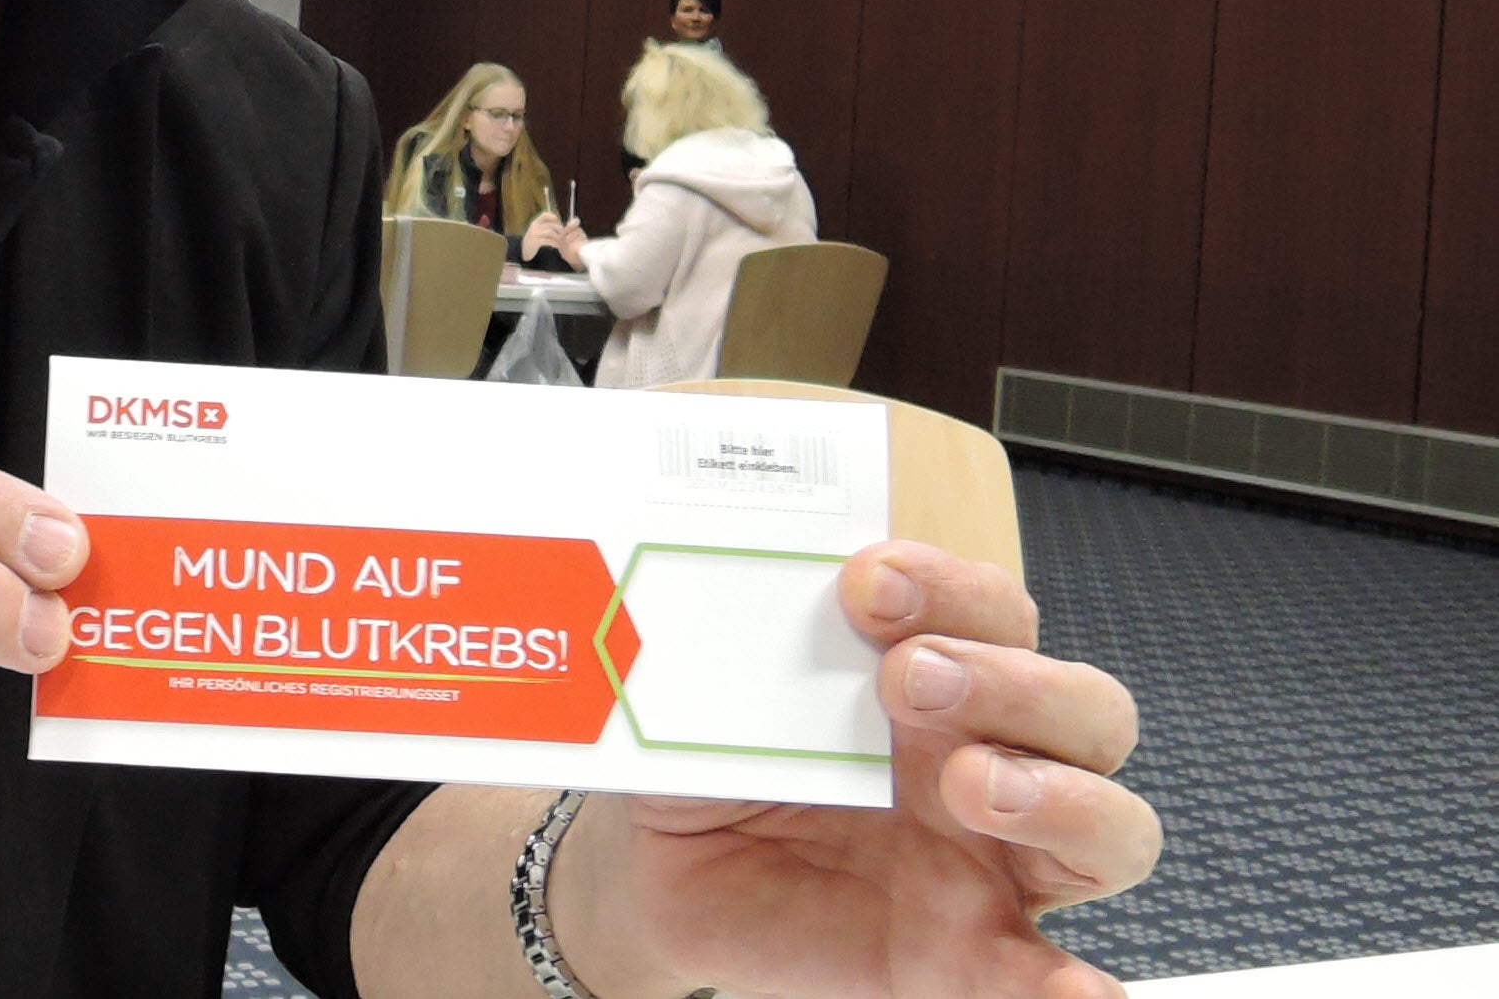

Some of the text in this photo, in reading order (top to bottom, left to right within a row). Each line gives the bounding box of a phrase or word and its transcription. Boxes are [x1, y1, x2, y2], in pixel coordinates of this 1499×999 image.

[87, 394, 194, 429] DKMS
[86, 430, 228, 445] WIR BESIEGEN BLUTKREBS
[720, 444, 775, 457] Bitte hier
[697, 457, 736, 471] Etikett
[172, 545, 462, 599] MUND AUF
[69, 606, 569, 673] GEGEN BLUTKREBS!
[168, 676, 461, 702] IHR PERSÖNLICHES REGISTRIERUNGSSET
